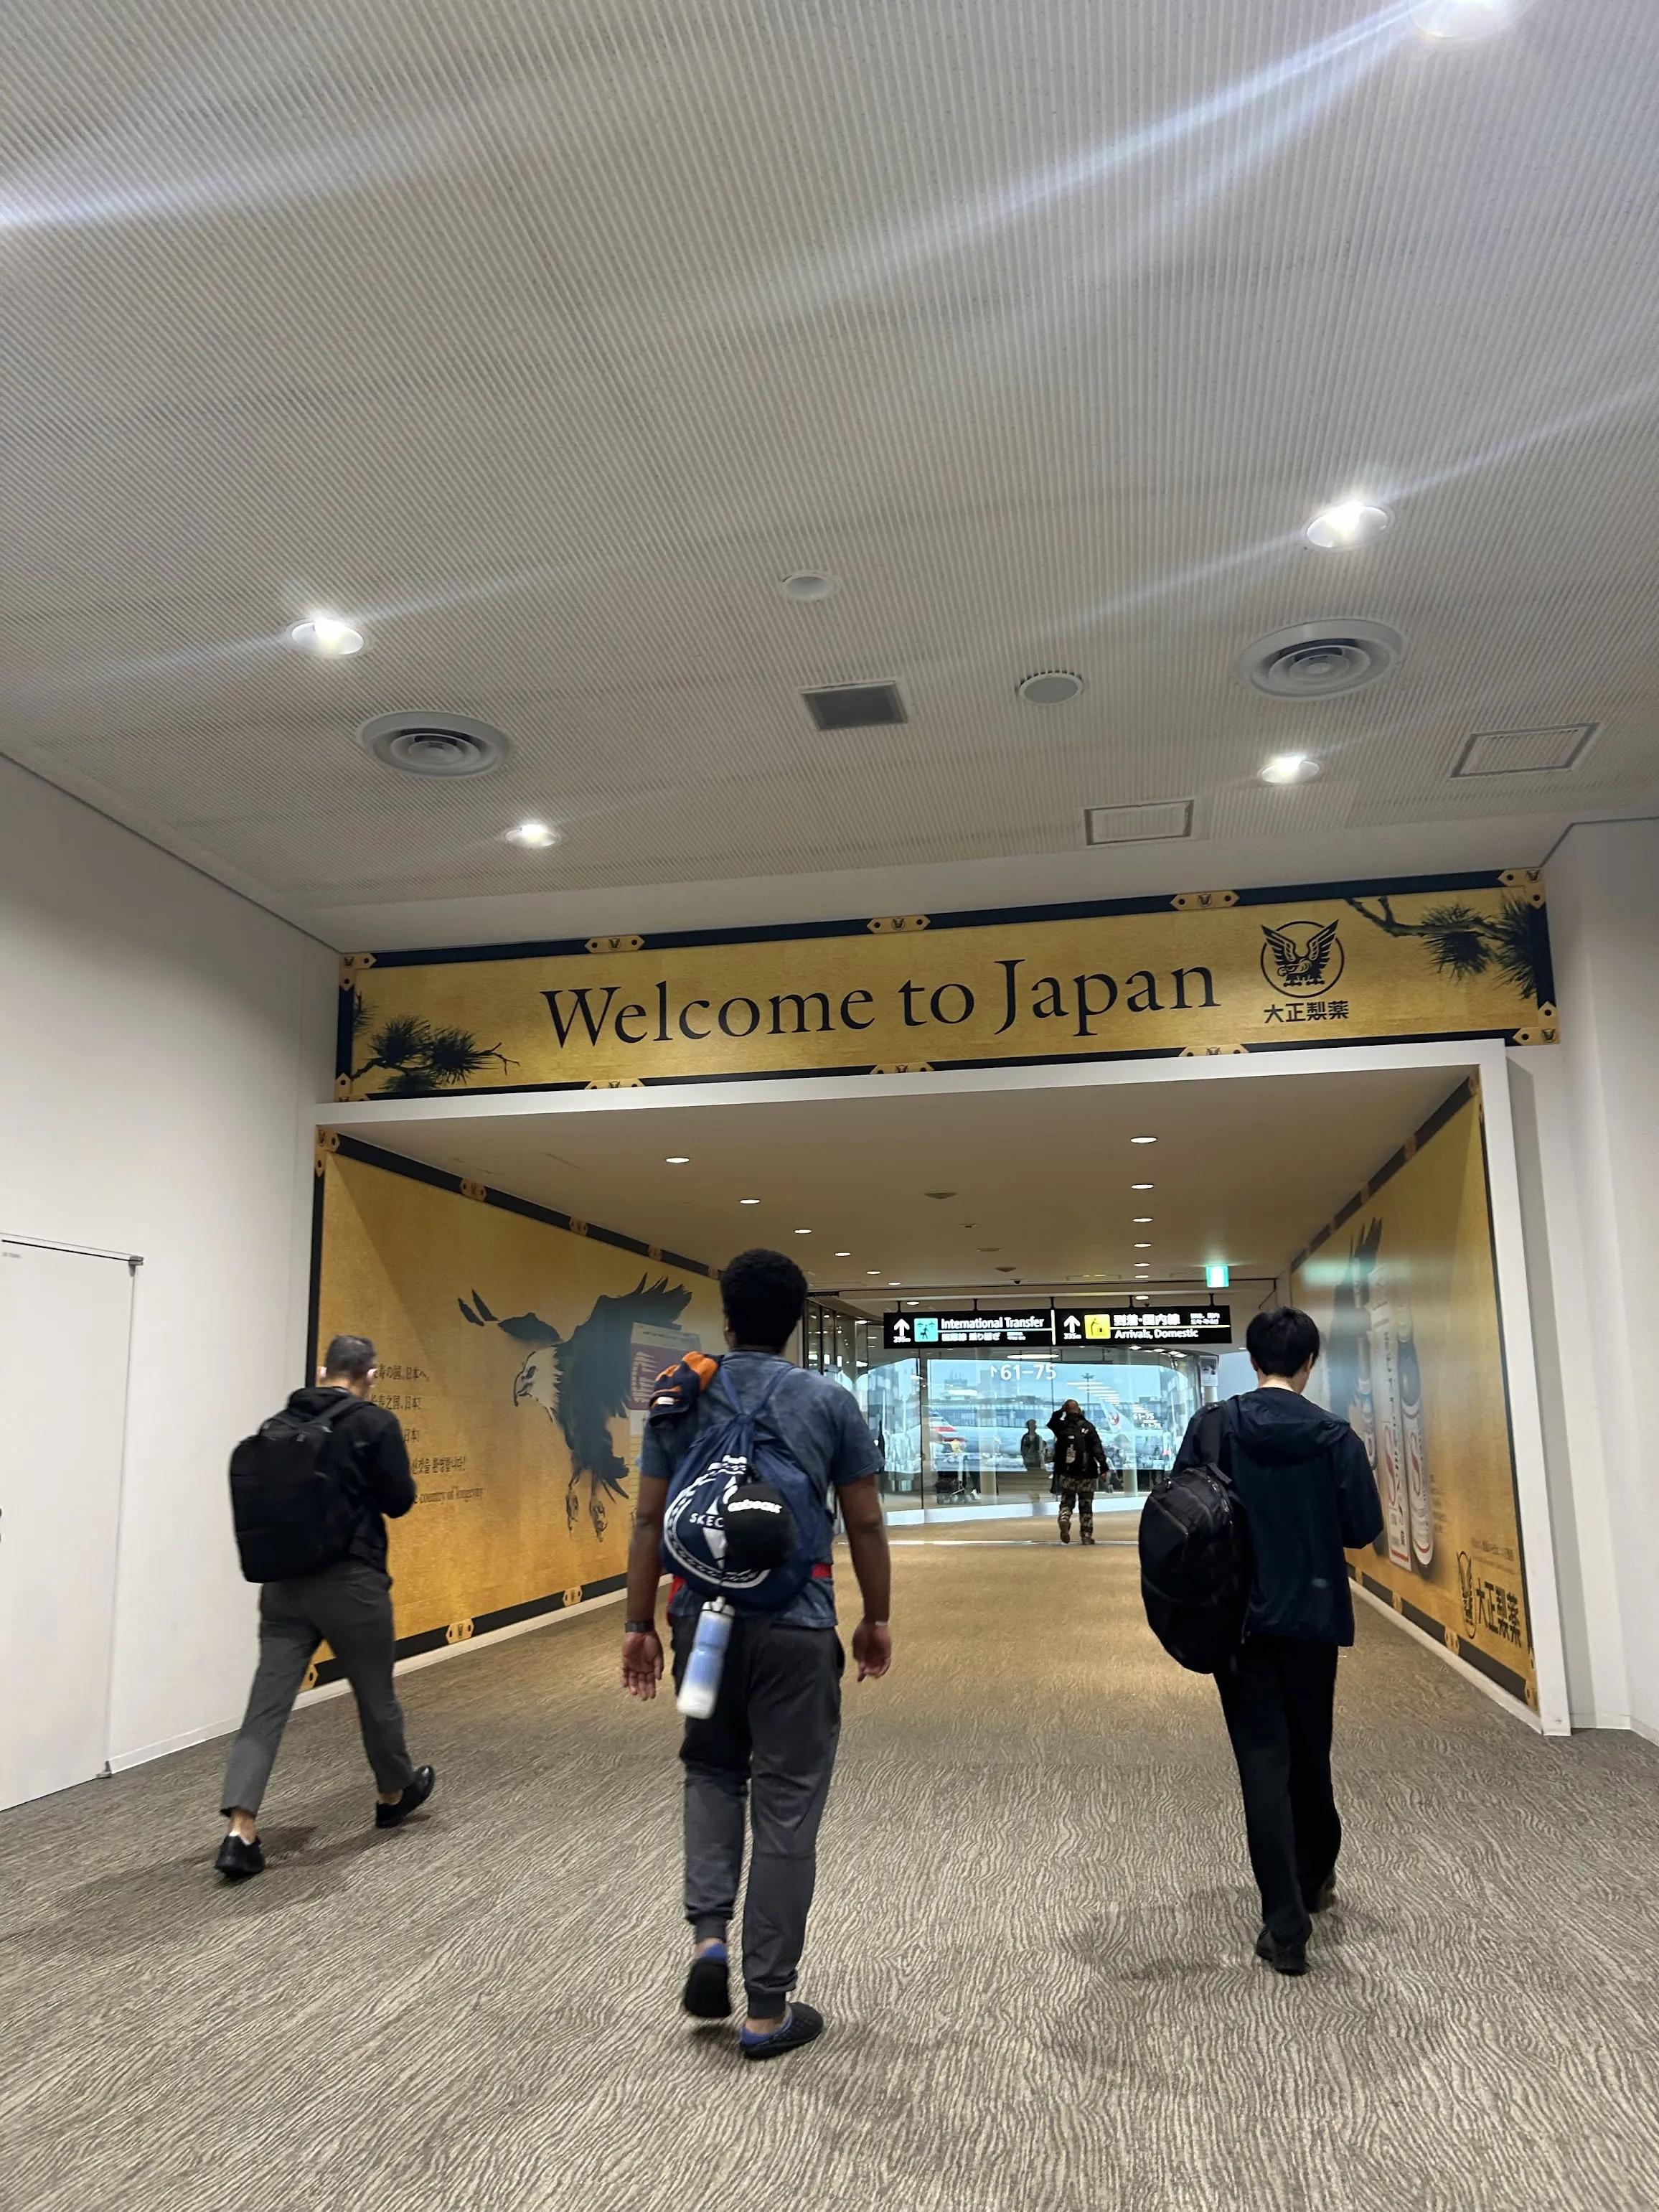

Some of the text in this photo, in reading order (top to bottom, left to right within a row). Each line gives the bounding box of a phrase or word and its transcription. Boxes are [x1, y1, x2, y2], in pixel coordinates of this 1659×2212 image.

[540, 958, 1221, 1049] Welcome to Japan
[1264, 1000, 1349, 1023] 大正製薬
[941, 1316, 1044, 1329] International Transfer
[1114, 1328, 1198, 1339] Arrivals, Domestic
[1000, 1364, 1057, 1381] 61-75
